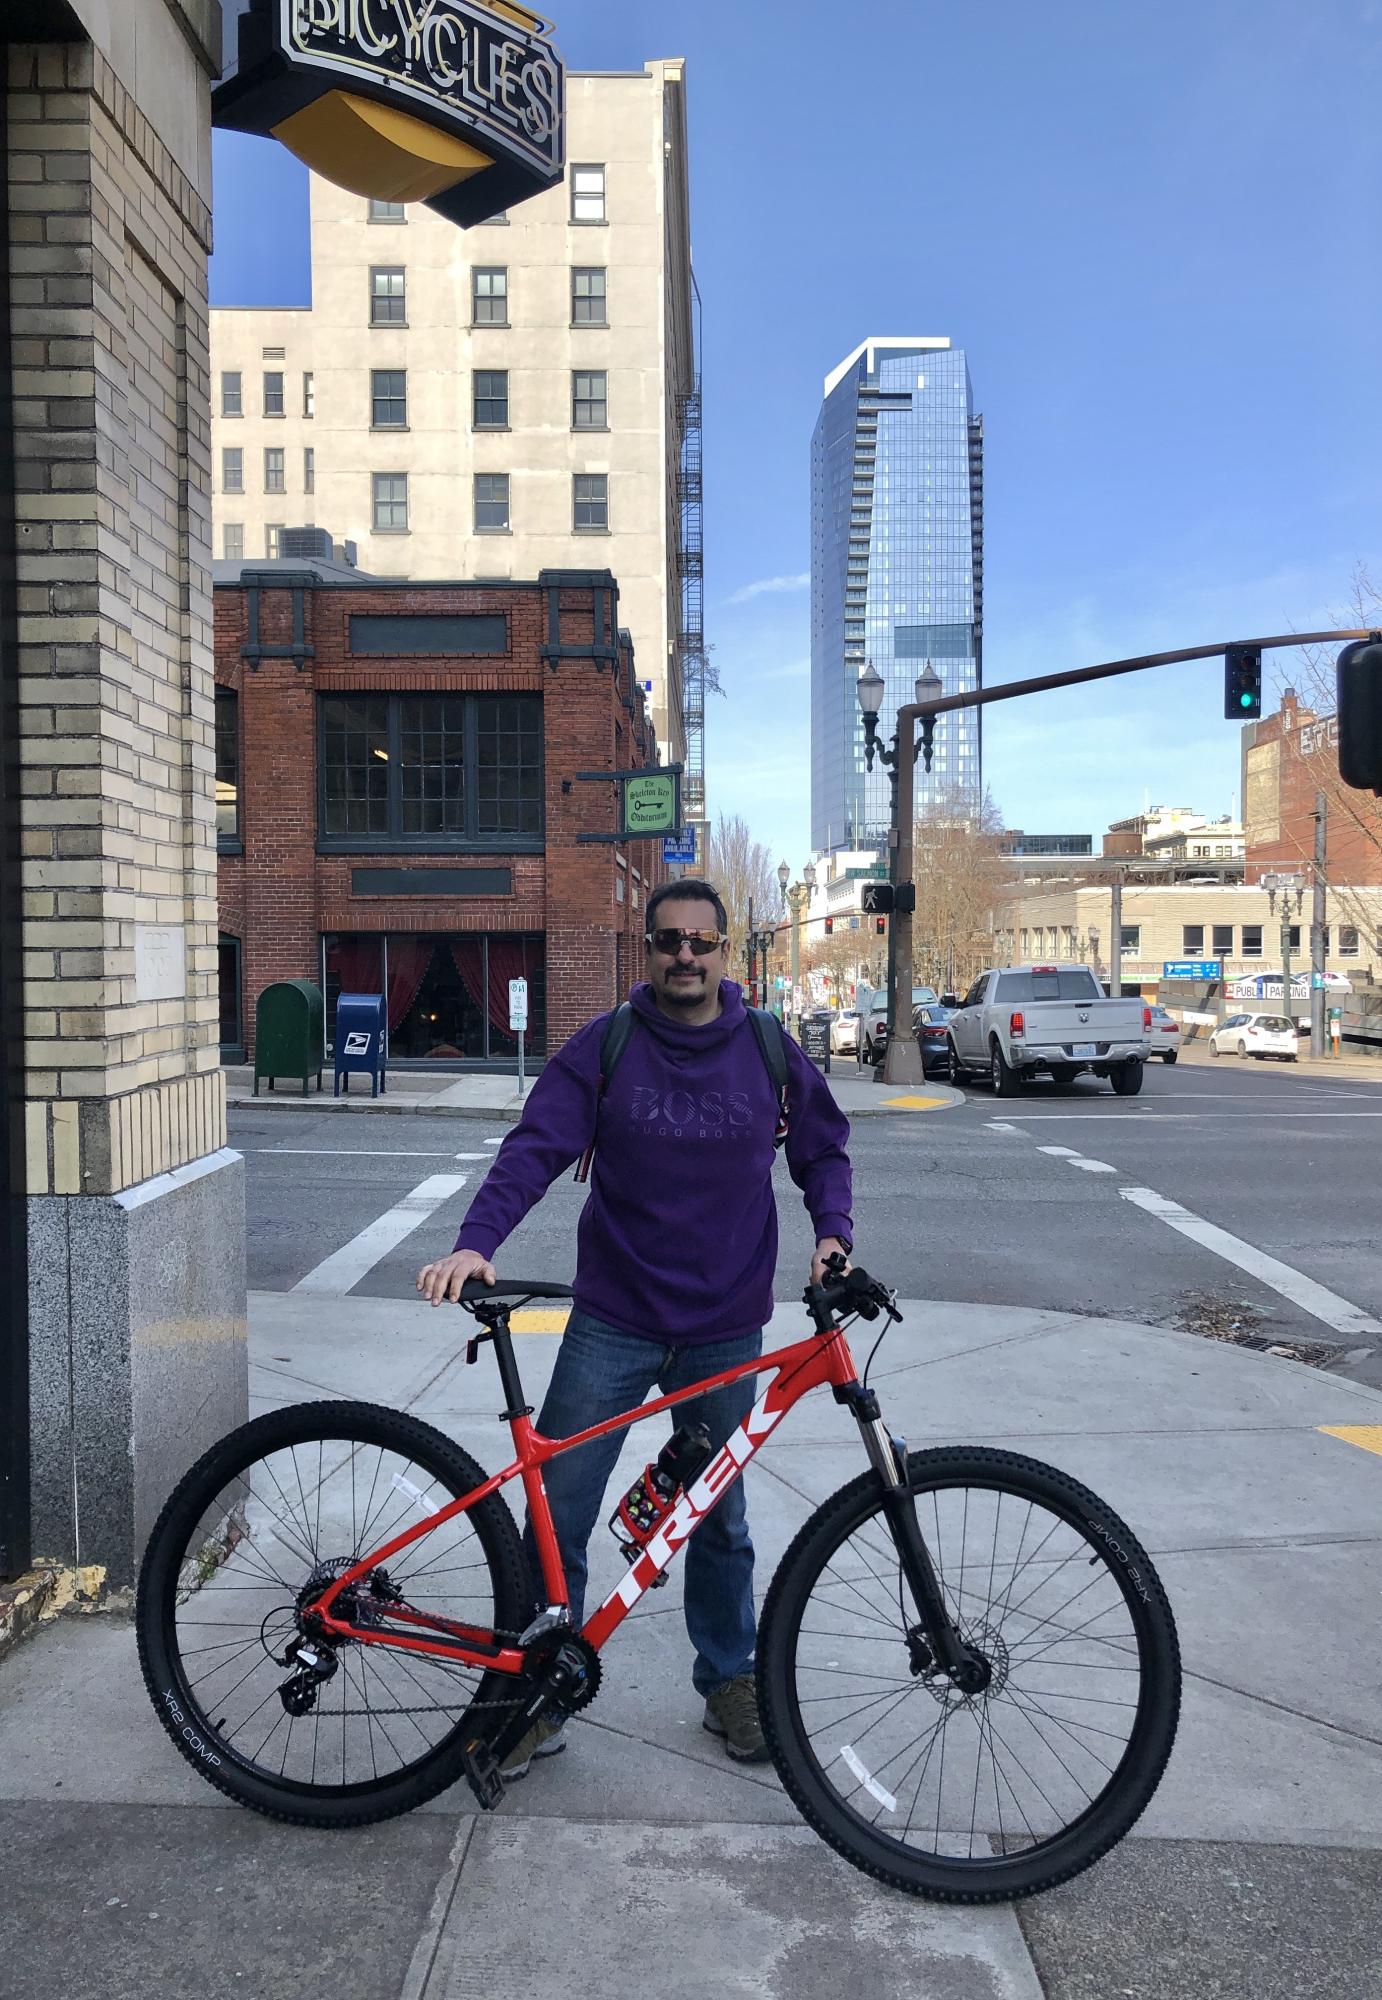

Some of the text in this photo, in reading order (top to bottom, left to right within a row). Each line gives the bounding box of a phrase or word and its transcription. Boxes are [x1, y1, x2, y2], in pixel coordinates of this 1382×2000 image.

[1236, 986, 1257, 997] PUBL
[1270, 986, 1307, 998] PARING
[630, 1127, 752, 1139] HUGO BOSS
[631, 1085, 753, 1126] BOSS
[602, 1365, 783, 1610] TREK
[1088, 1521, 1153, 1604] XR2 COMP
[162, 1688, 221, 1766] XR2 COMP
